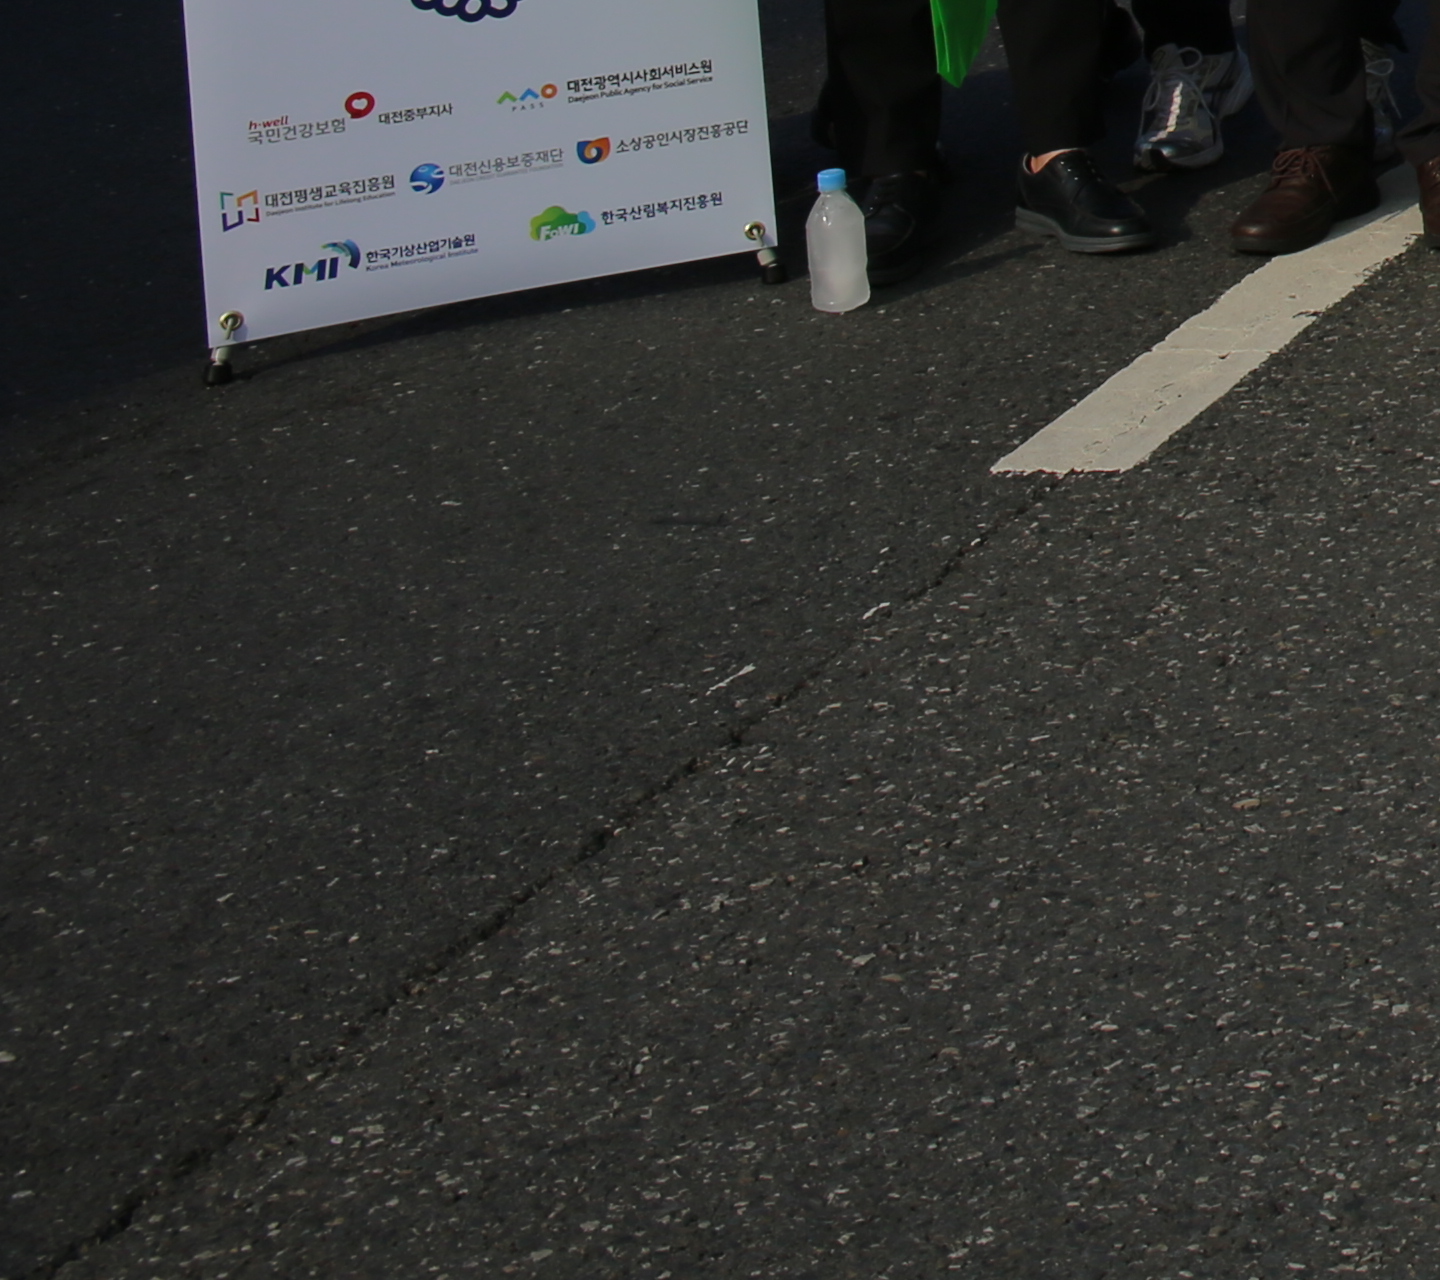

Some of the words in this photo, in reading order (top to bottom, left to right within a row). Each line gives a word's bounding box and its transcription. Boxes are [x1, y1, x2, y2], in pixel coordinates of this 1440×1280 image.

[566, 59, 713, 94] 대전광역시사회서비스원
[567, 93, 600, 104] Daejeon
[247, 118, 346, 146] 국민건강보험
[378, 102, 454, 126] 대전중부지사
[615, 119, 749, 155] 소상공인시장진흥공단
[449, 147, 564, 178] 대전신용보증재단
[264, 174, 396, 208] 대전평생교육진흥원
[600, 191, 724, 226] 한국산림복지진흥원
[365, 233, 476, 264] 한국기상산업기술원
[264, 256, 340, 290] KMI
